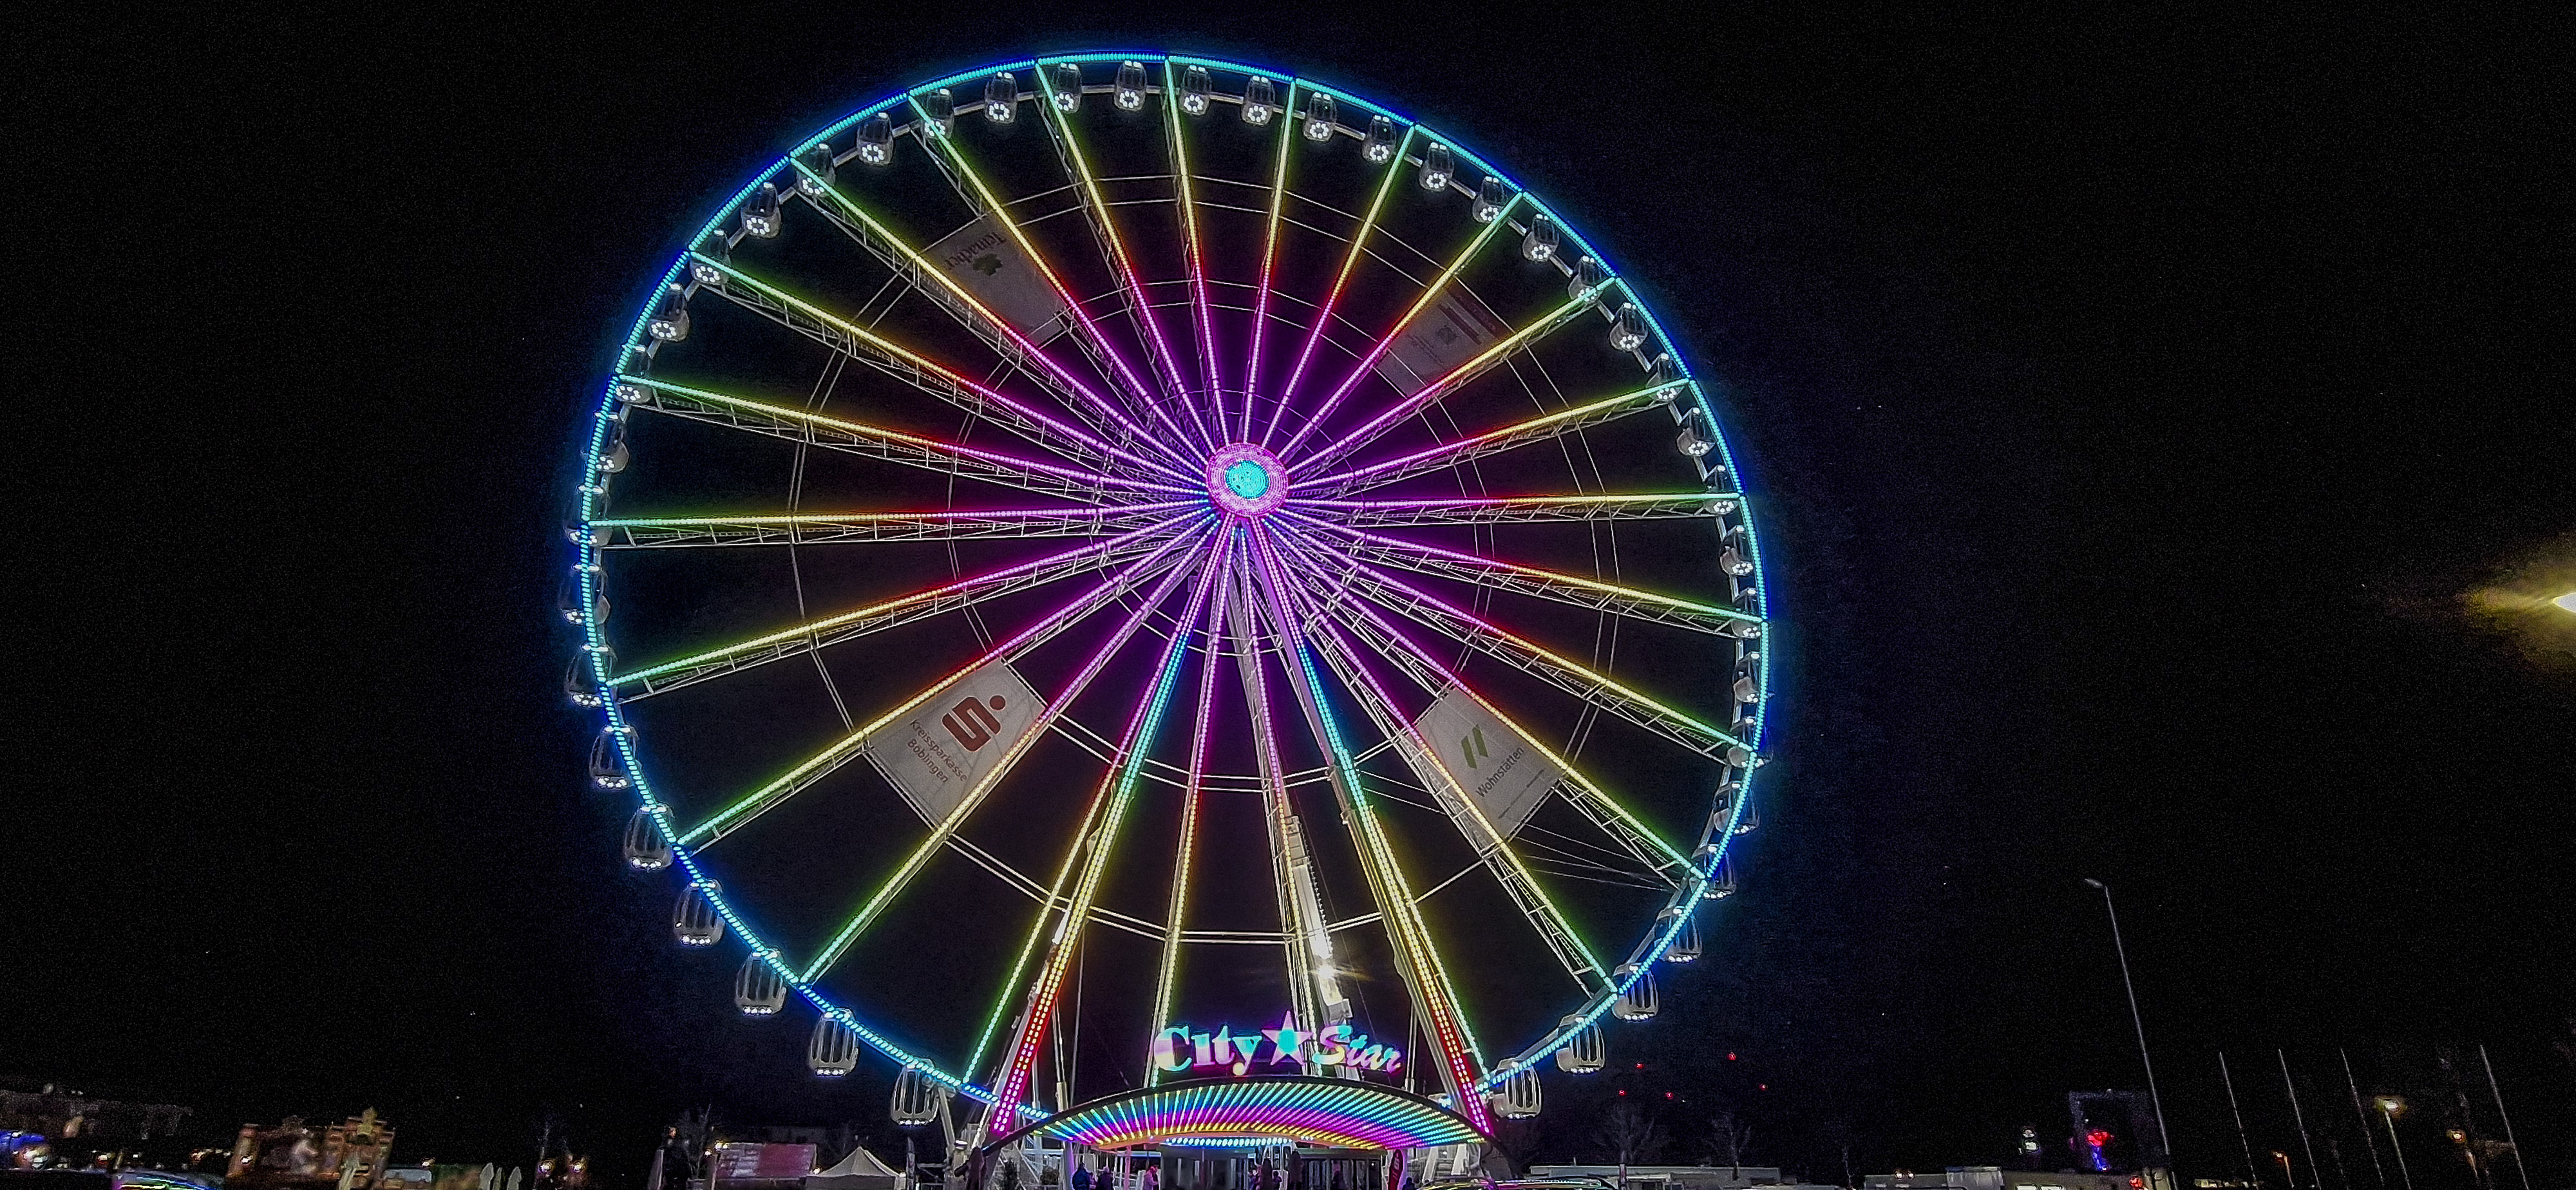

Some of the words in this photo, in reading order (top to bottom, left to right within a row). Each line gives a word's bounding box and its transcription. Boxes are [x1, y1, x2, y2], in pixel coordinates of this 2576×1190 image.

[911, 720, 968, 782] Kreissparkasse
[1153, 1024, 1262, 1076] City
[1312, 1024, 1403, 1074] Star
